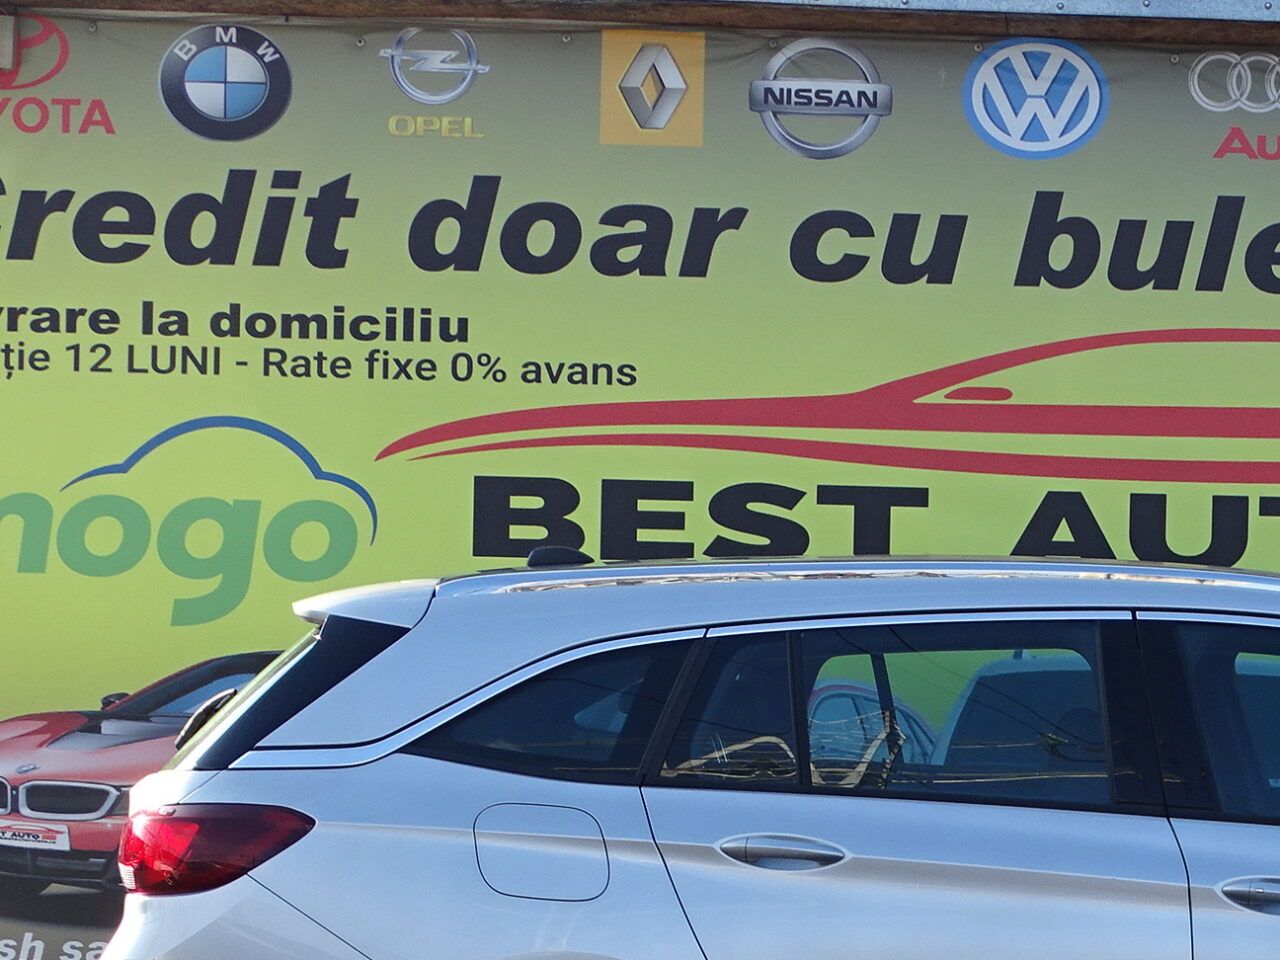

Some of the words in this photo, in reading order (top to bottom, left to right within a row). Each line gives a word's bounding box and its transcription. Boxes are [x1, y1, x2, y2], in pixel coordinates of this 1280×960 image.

[173, 26, 281, 63] BMW
[0, 97, 116, 134] OTA
[763, 87, 879, 110] NISSAN
[388, 115, 486, 138] OPEL
[0, 168, 360, 269] redit
[407, 175, 750, 279] doar
[788, 209, 969, 286] cu
[0, 305, 121, 336] rare
[142, 301, 190, 337] la
[210, 302, 470, 343] domiciliu
[65, 343, 113, 373] 12
[127, 344, 222, 376] LUNI
[262, 347, 353, 380] Rate
[364, 349, 438, 383] fixe
[451, 351, 508, 384] 0%
[520, 361, 638, 386] avans
[472, 475, 929, 557] BEST
